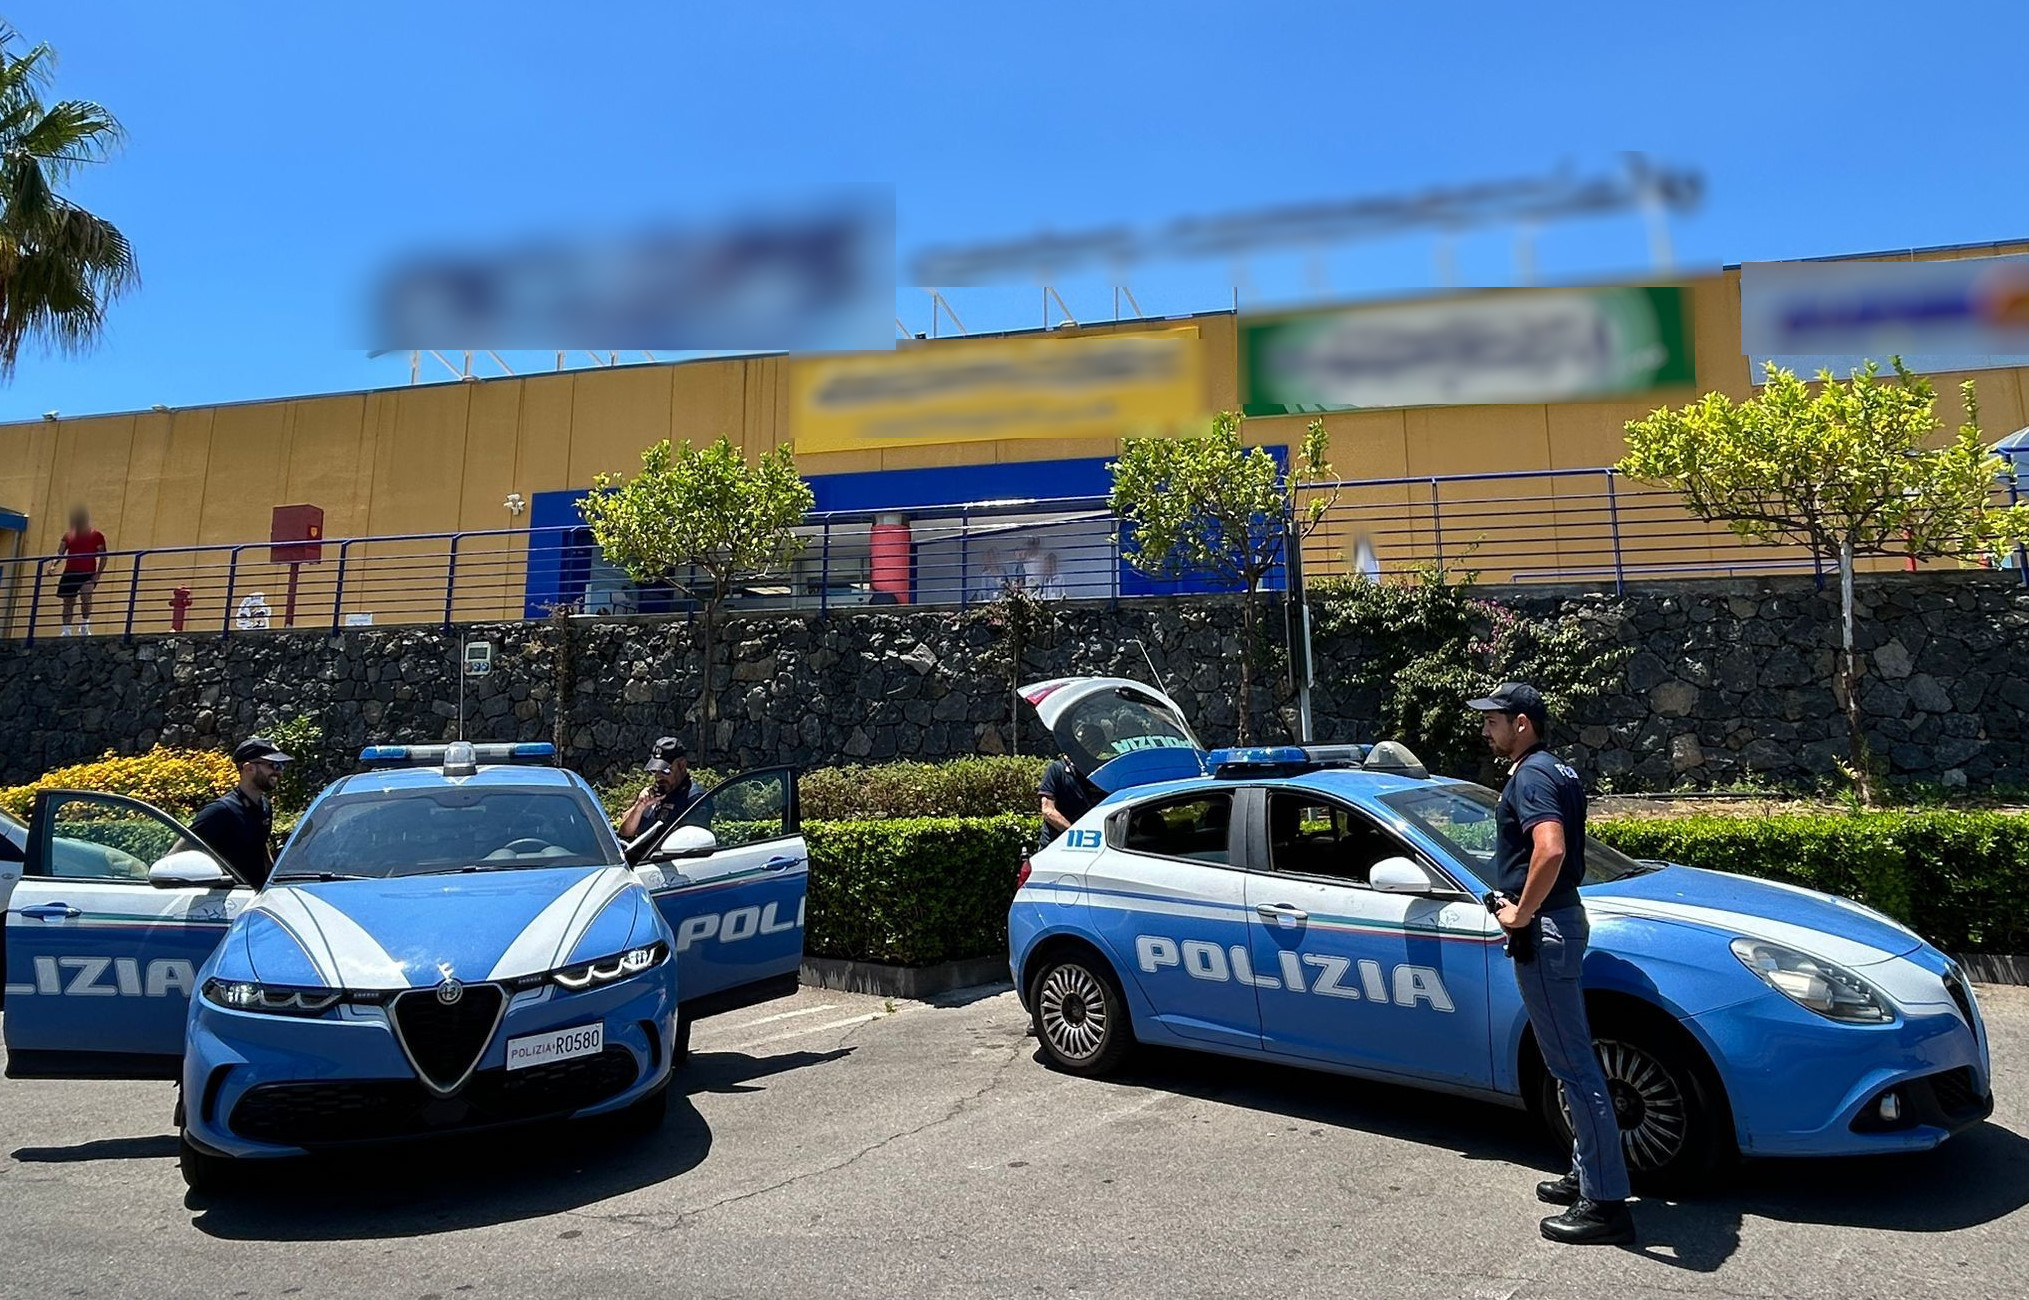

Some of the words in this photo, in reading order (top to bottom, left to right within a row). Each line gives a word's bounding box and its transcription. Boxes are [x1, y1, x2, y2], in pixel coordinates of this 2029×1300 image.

[1067, 830, 1102, 848] 113
[1135, 934, 1455, 1013] POLIZIA
[511, 1043, 552, 1059] POLIZIA
[556, 1030, 600, 1054] R0580
